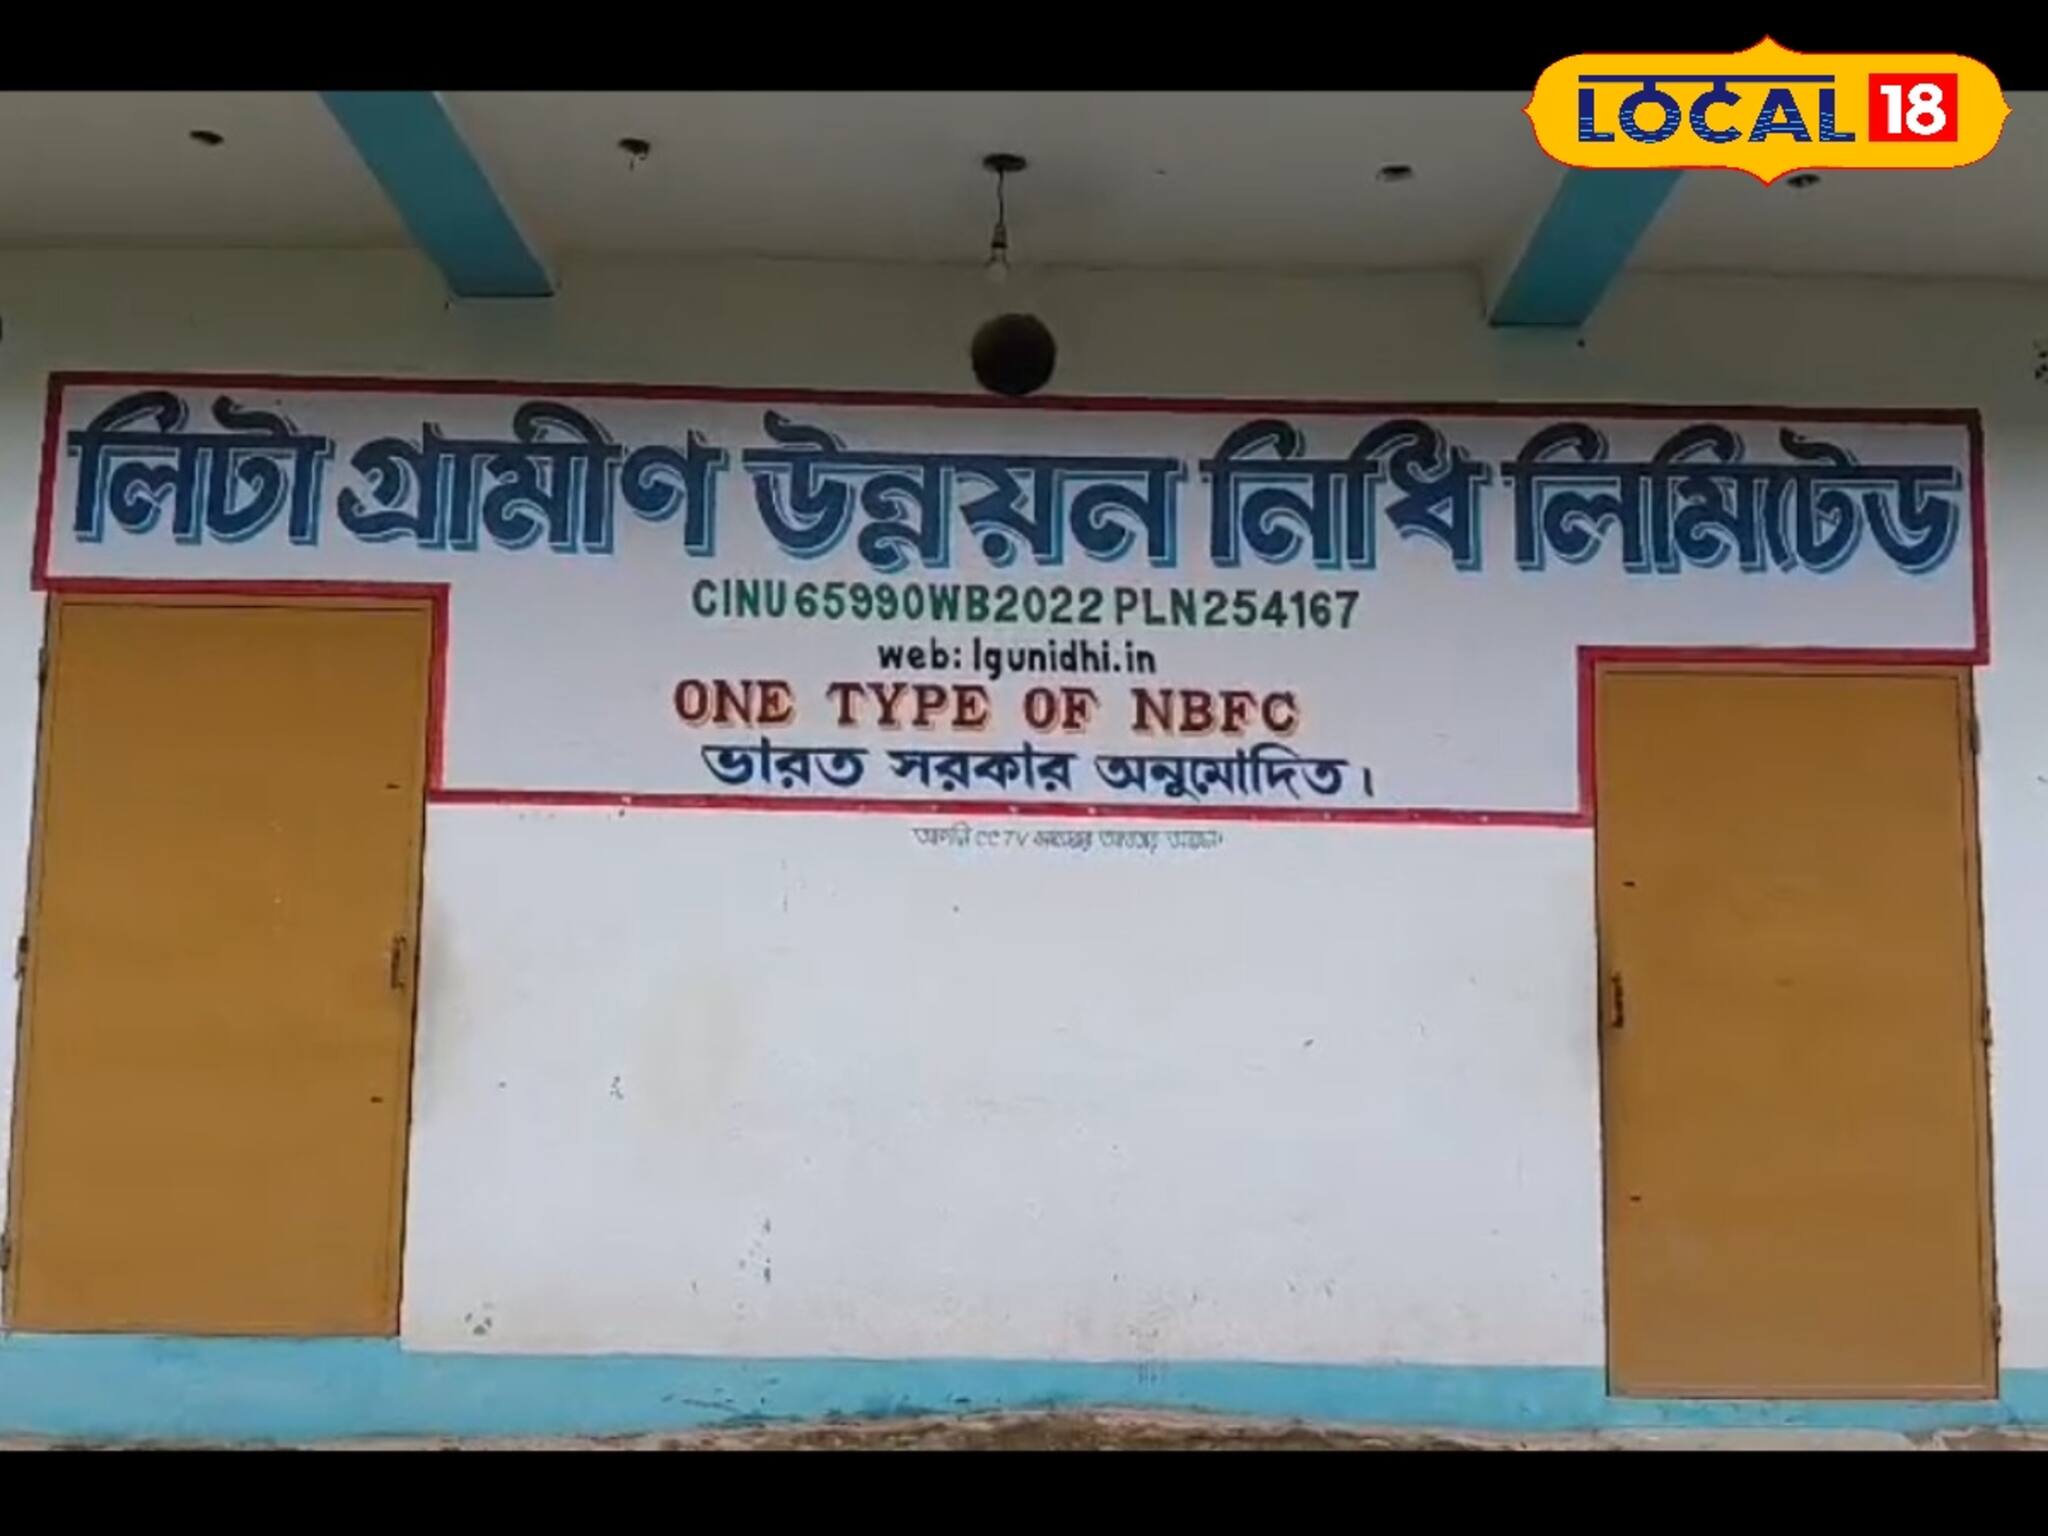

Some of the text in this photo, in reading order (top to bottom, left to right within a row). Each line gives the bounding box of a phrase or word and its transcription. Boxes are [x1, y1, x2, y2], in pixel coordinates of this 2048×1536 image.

[67, 390, 1963, 575] লিটা গ্রামীণ উন্নয়ন নিধি লিমিটেড
[673, 678, 1304, 737] ONE TYPE OF NBFC
[700, 735, 869, 789] ভারত
[886, 741, 1079, 793] সরকার
